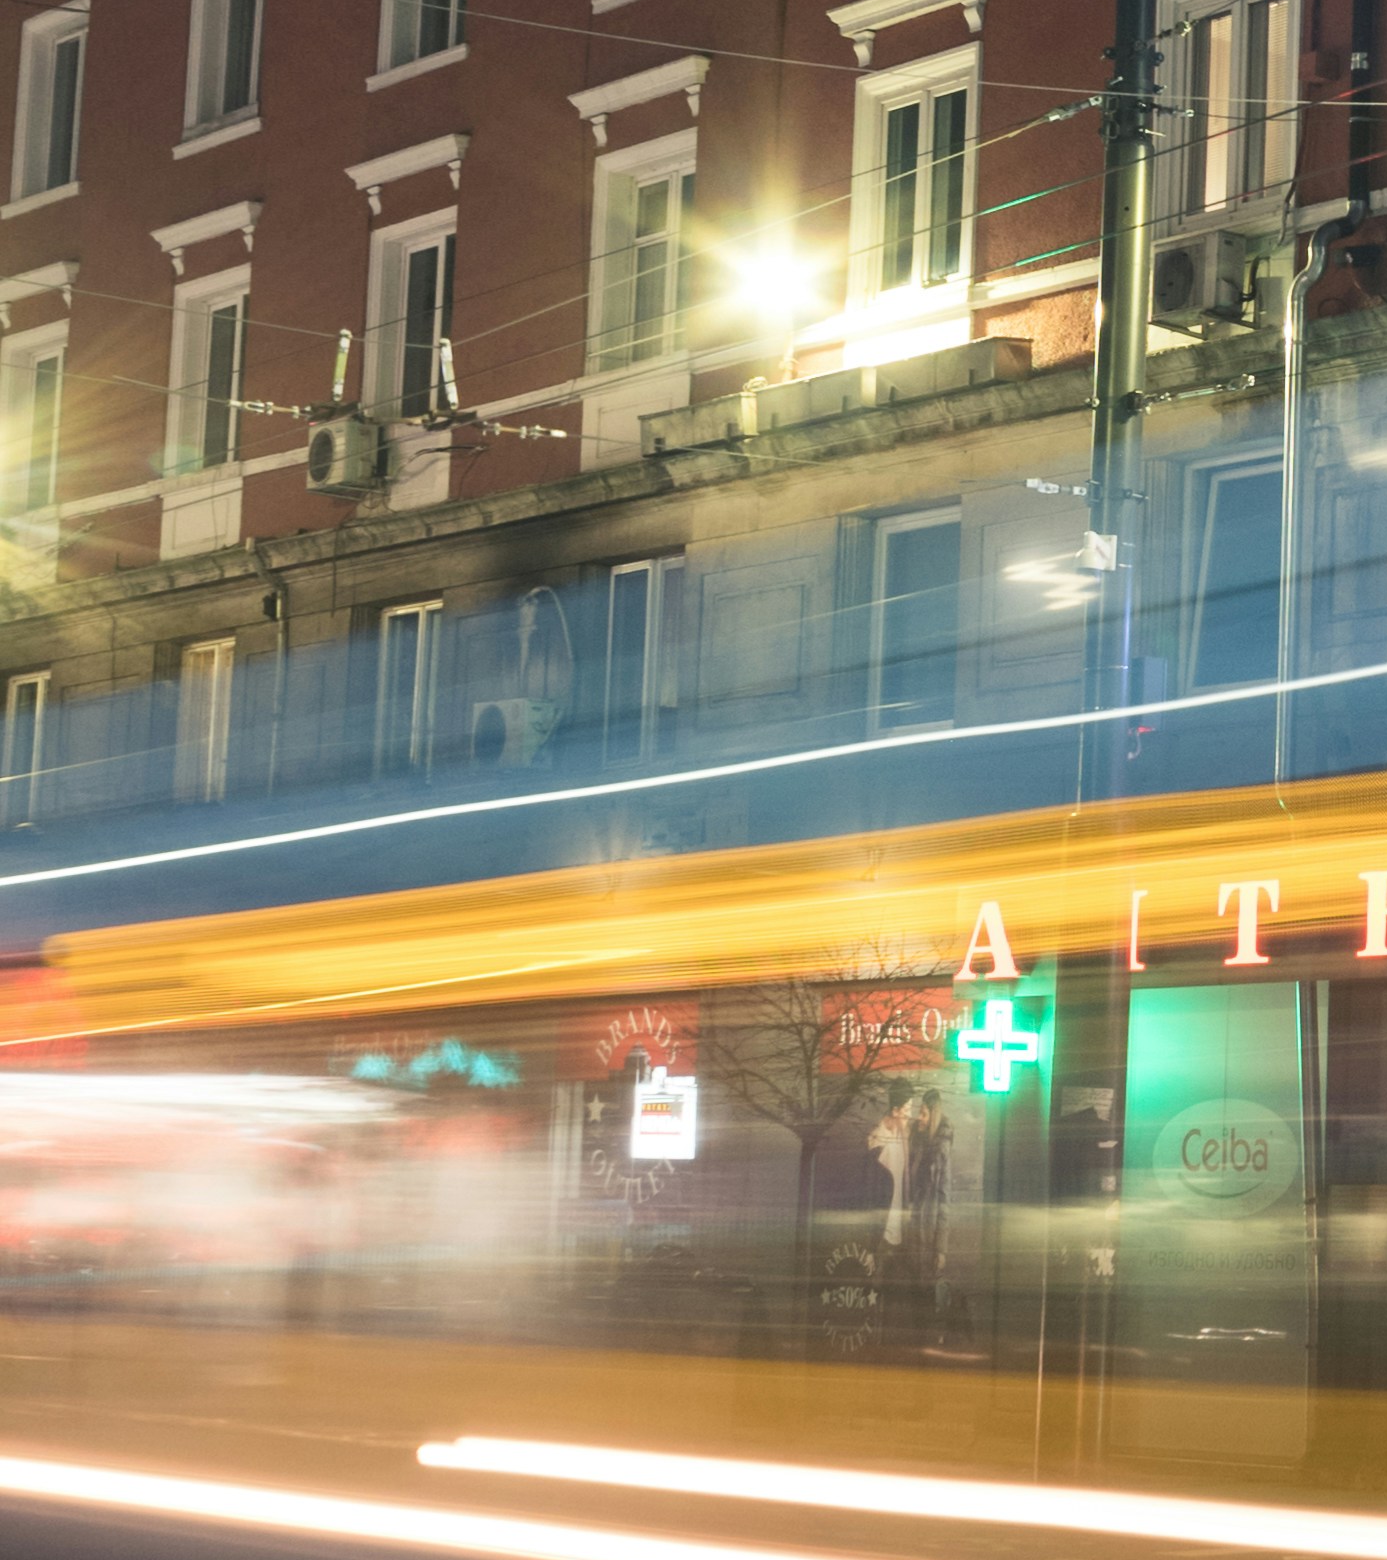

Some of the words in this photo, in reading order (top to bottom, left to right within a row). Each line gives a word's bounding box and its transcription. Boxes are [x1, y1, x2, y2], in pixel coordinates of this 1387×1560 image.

[595, 1007, 682, 1065] BRANDS
[838, 1009, 911, 1046] Brands
[1182, 1128, 1268, 1172] Ceiba
[1150, 1251, 1214, 1270] ИЗГОДНО
[1234, 1252, 1296, 1271] УДОБНО
